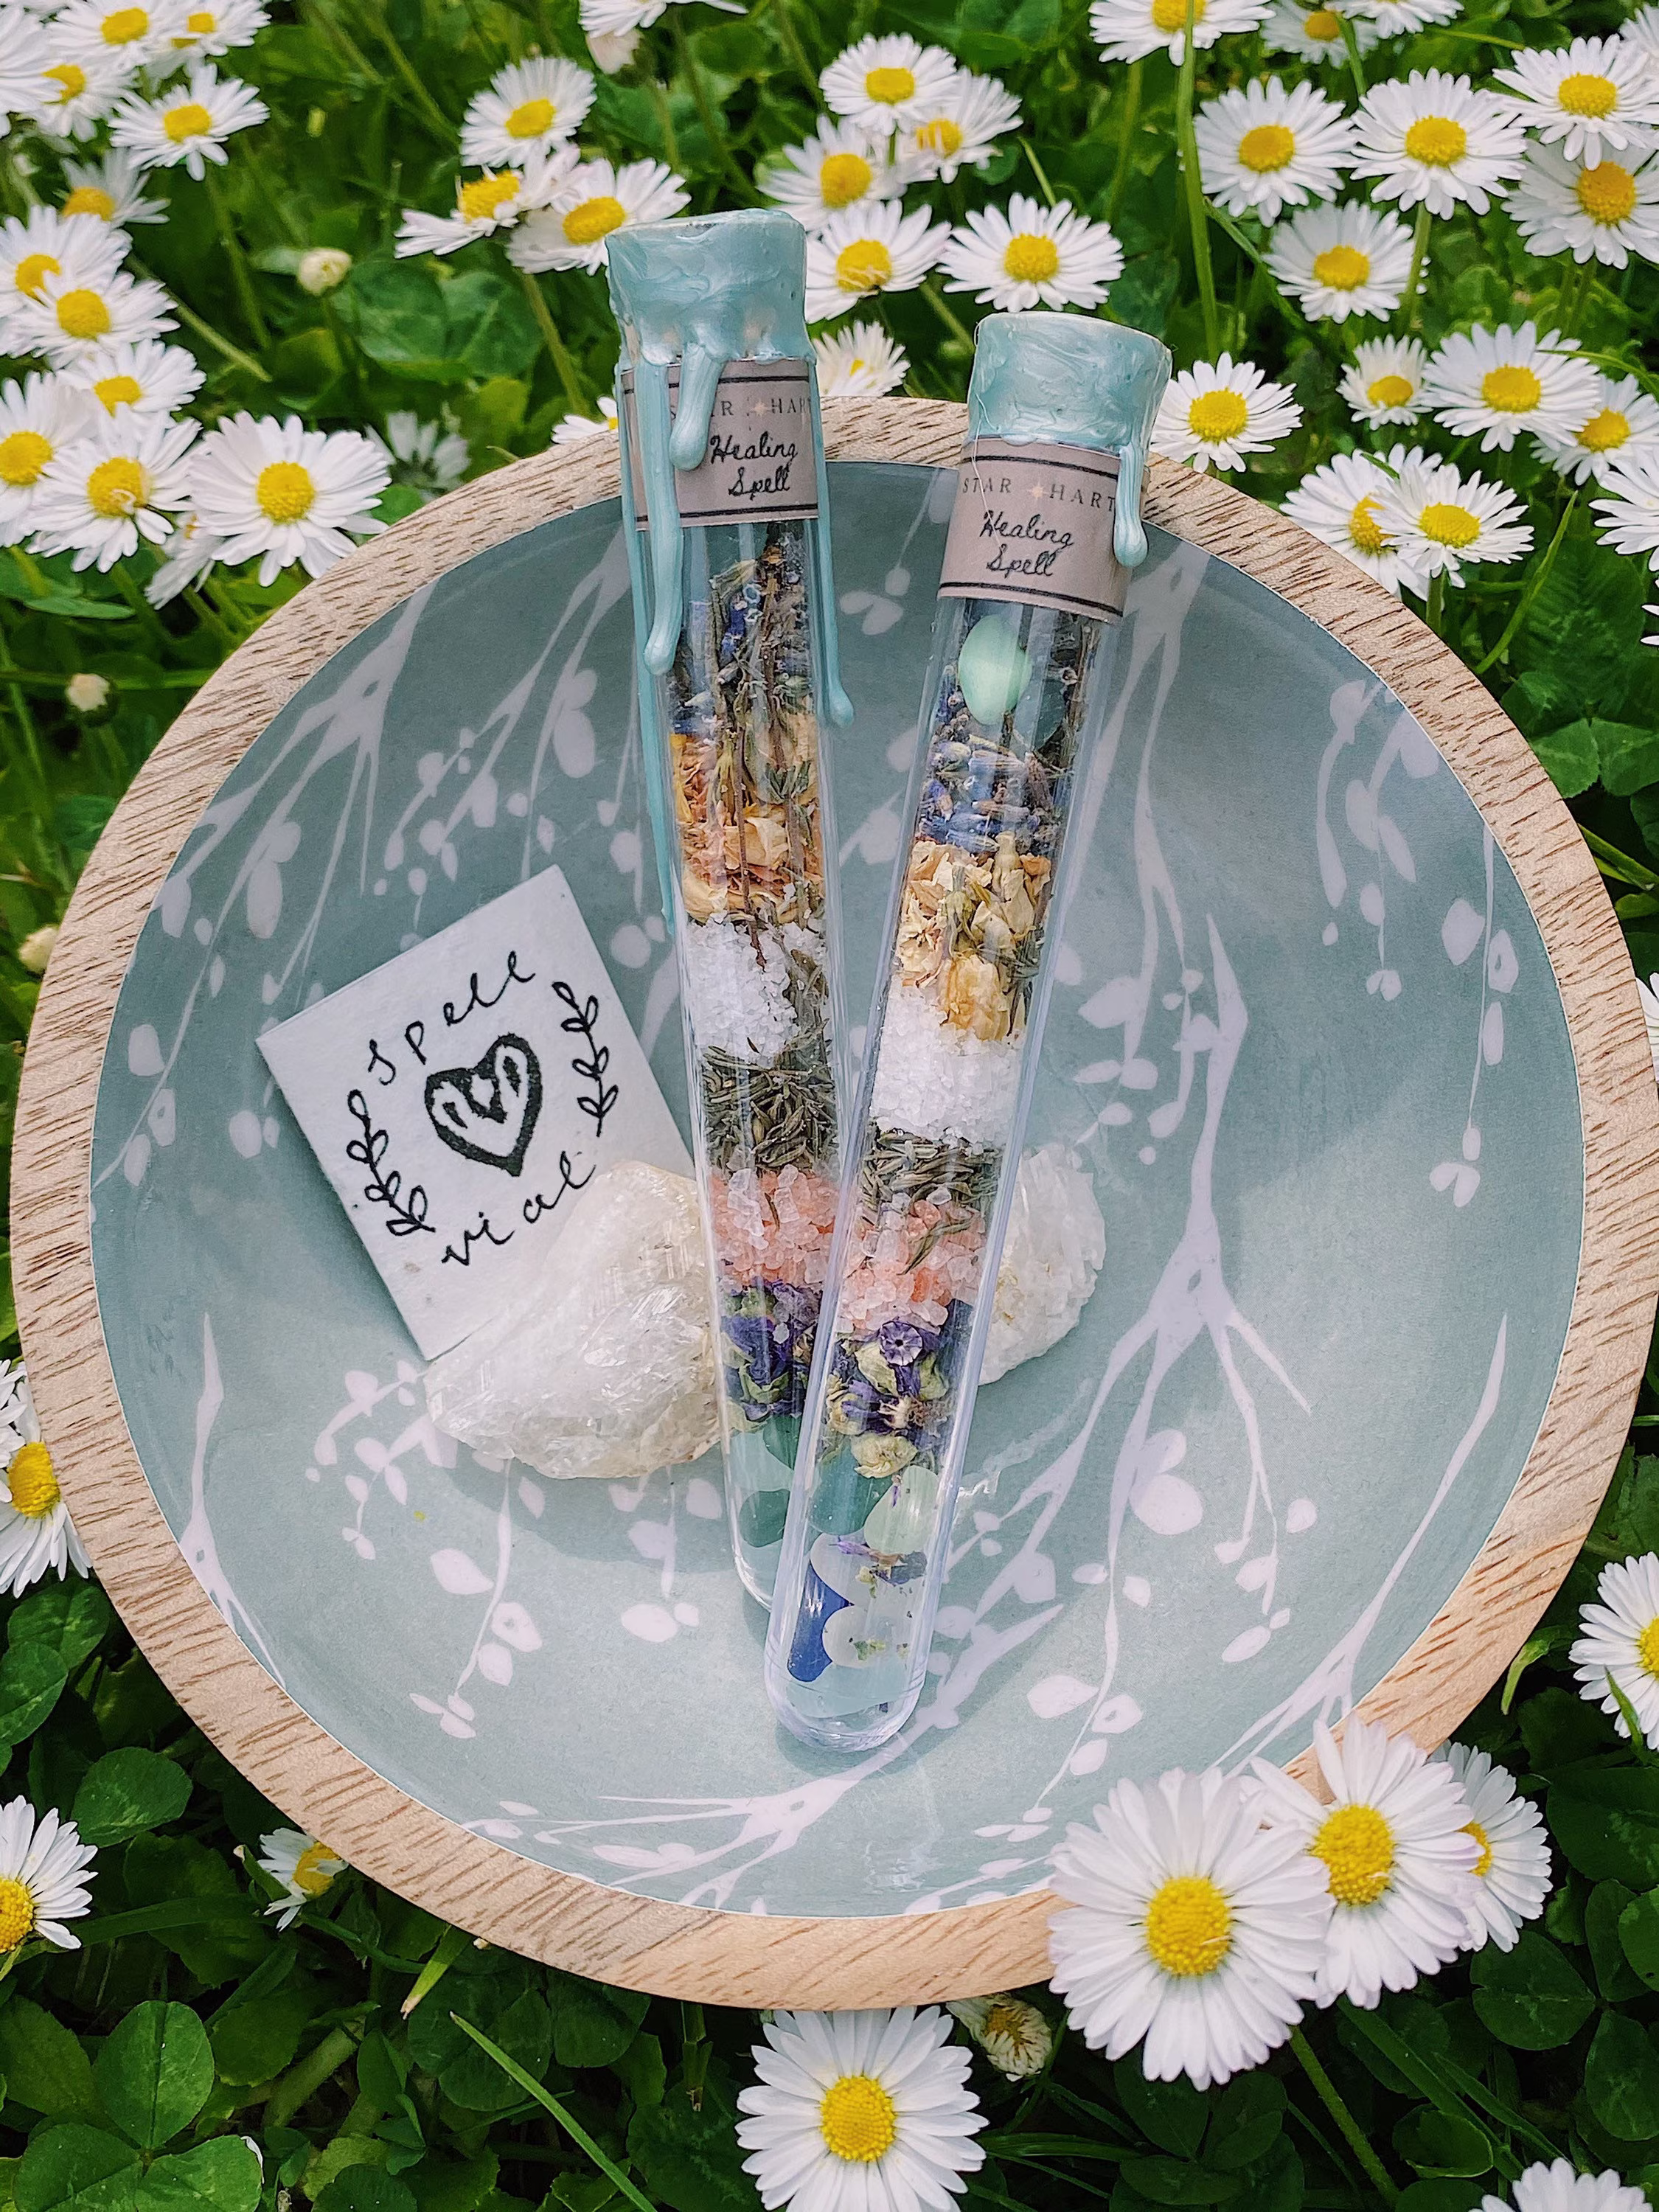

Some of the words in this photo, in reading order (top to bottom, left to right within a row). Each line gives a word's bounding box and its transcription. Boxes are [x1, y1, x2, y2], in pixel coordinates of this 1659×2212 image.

[709, 431, 799, 472] Healing
[728, 465, 791, 500] Spell
[961, 477, 1012, 494] STAR
[1049, 484, 1116, 512] HART
[979, 509, 1074, 552] Healing
[985, 543, 1057, 579] Spell
